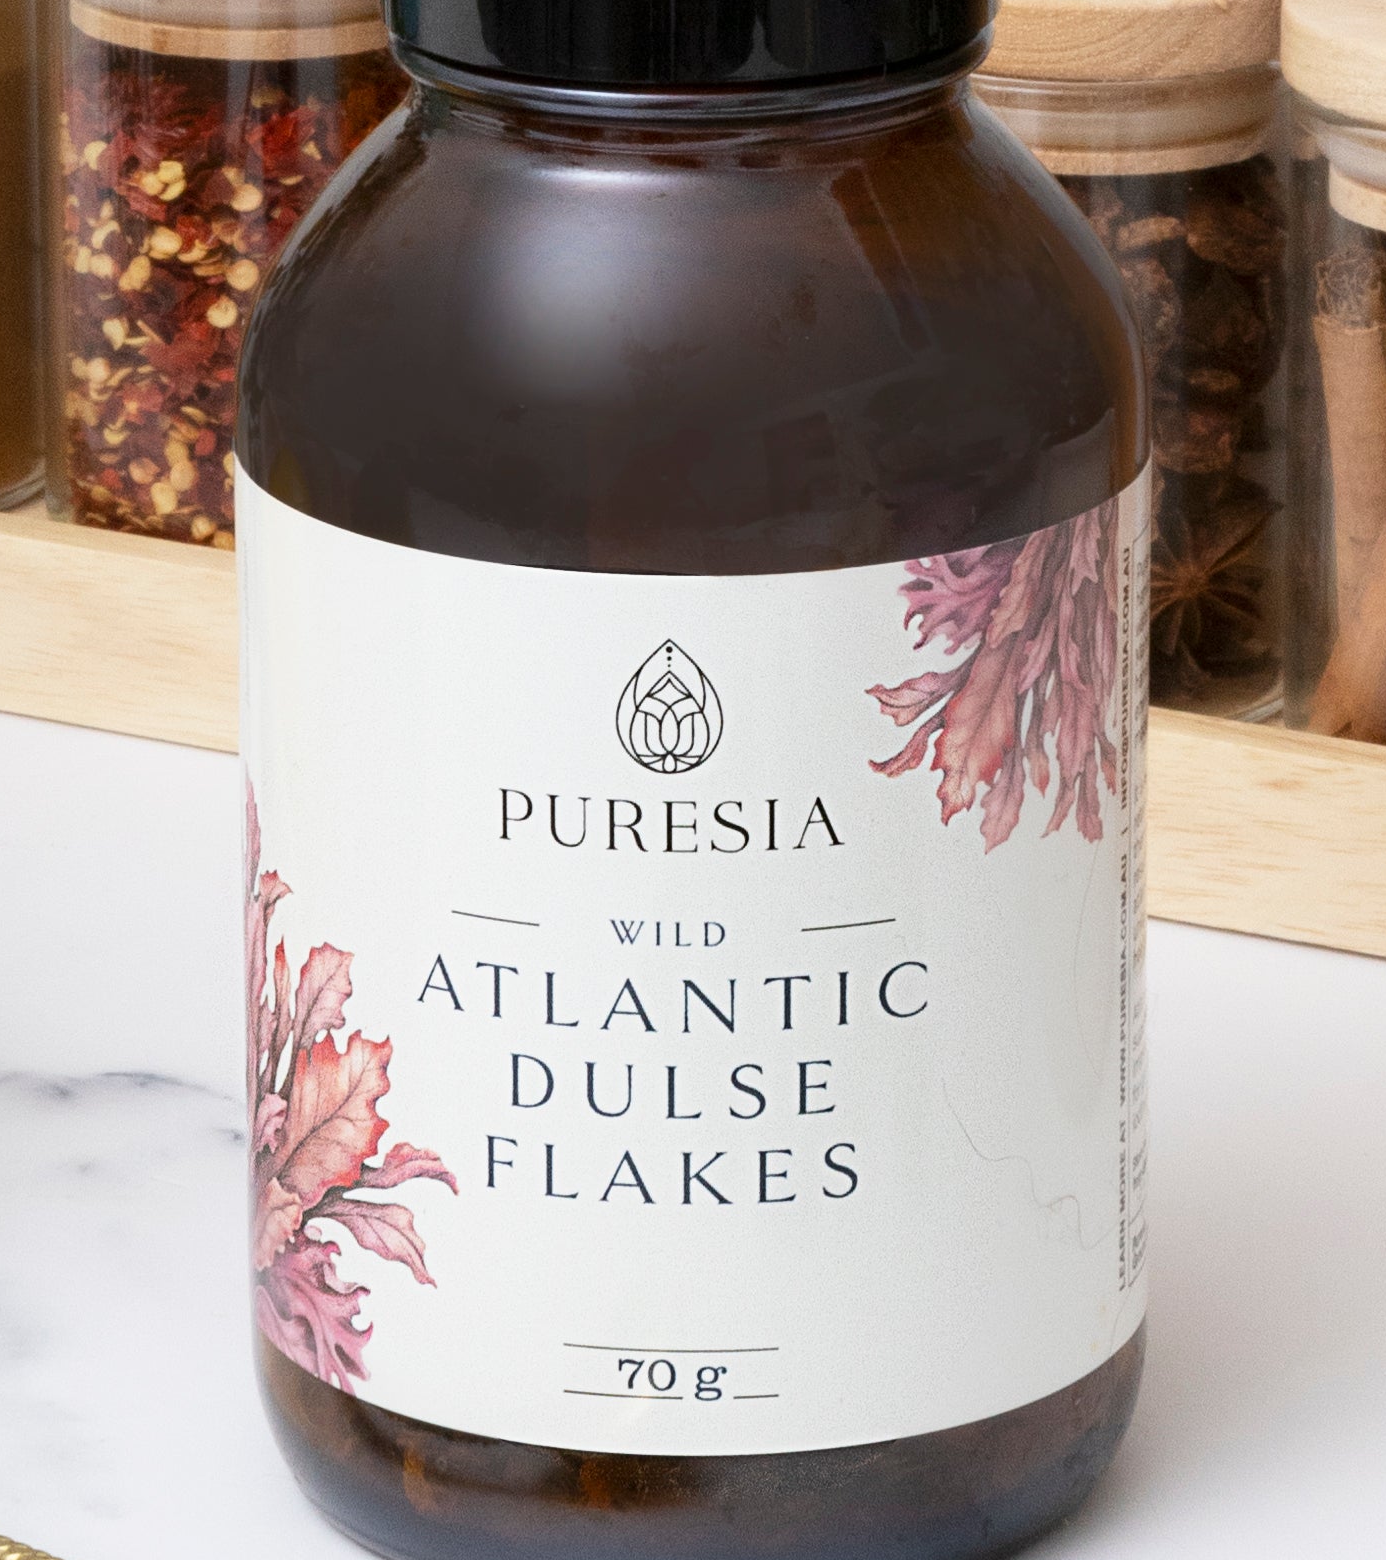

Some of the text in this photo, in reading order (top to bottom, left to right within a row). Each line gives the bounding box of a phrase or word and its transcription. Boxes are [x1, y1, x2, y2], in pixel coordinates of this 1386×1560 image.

[500, 788, 845, 854] PURESIA
[610, 919, 726, 947] WILD
[1118, 547, 1130, 1292] LEARN MORE AT WWW.PURESIA.COM.AU INFO@PURESIA.COM.AU
[417, 954, 928, 1034] ATLANTIC
[511, 1053, 836, 1120] DULSE
[487, 1135, 858, 1205] FLAKES
[618, 1358, 728, 1402] 70 g
